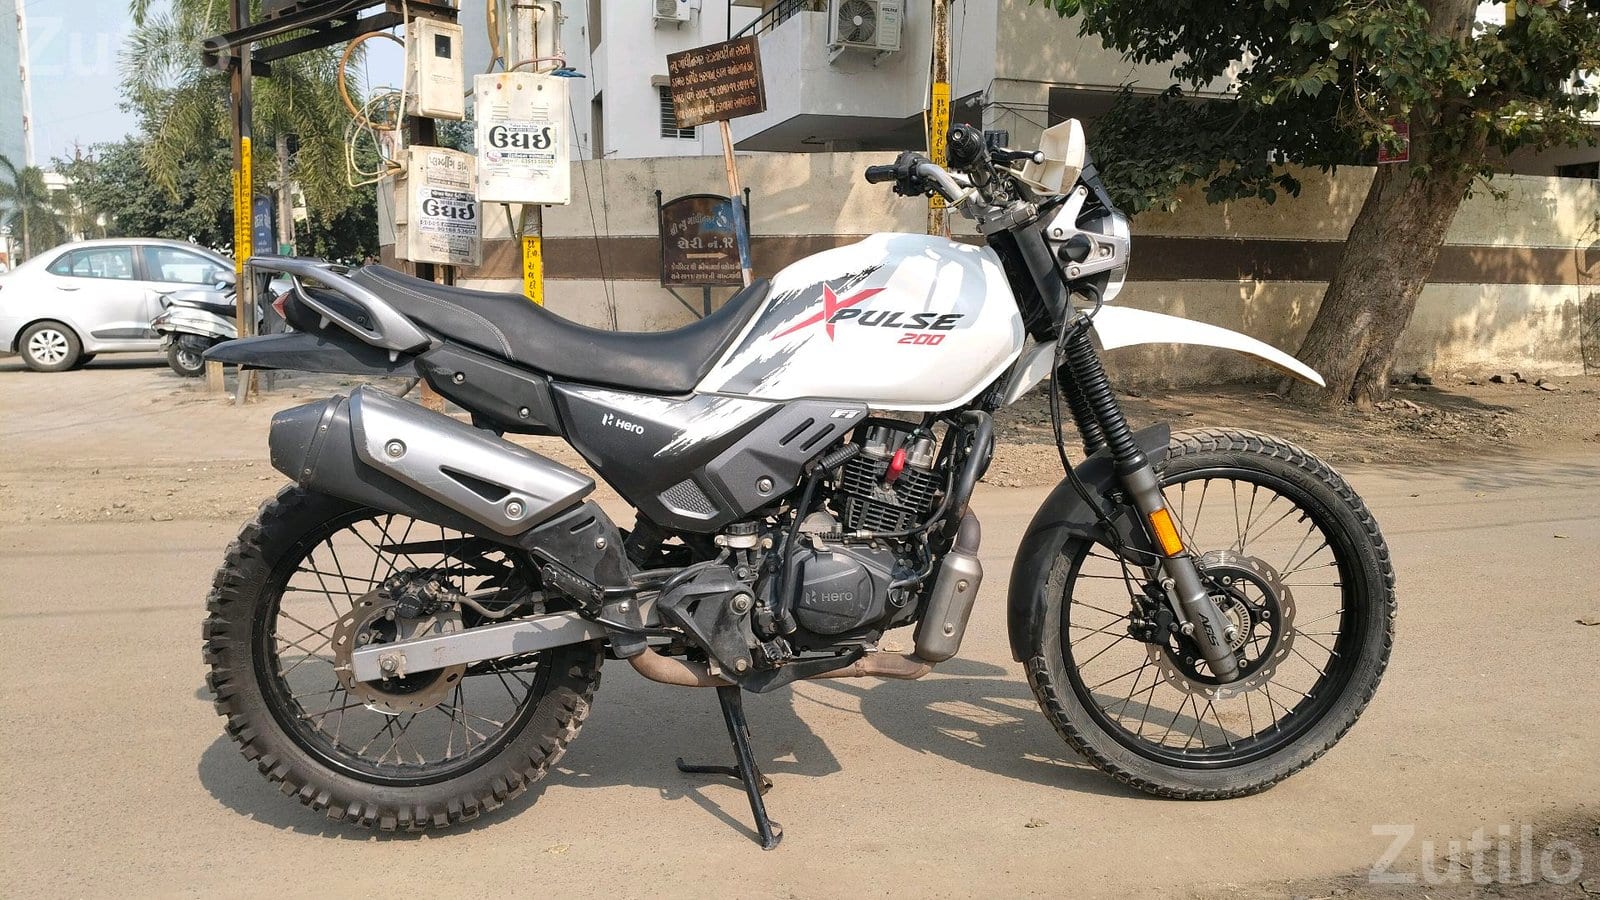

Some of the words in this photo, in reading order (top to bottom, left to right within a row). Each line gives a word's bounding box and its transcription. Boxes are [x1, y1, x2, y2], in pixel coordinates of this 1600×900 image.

[678, 237, 703, 249] શેરી
[897, 333, 946, 346] 200
[615, 418, 644, 434] Hero
[821, 592, 854, 602] Hero
